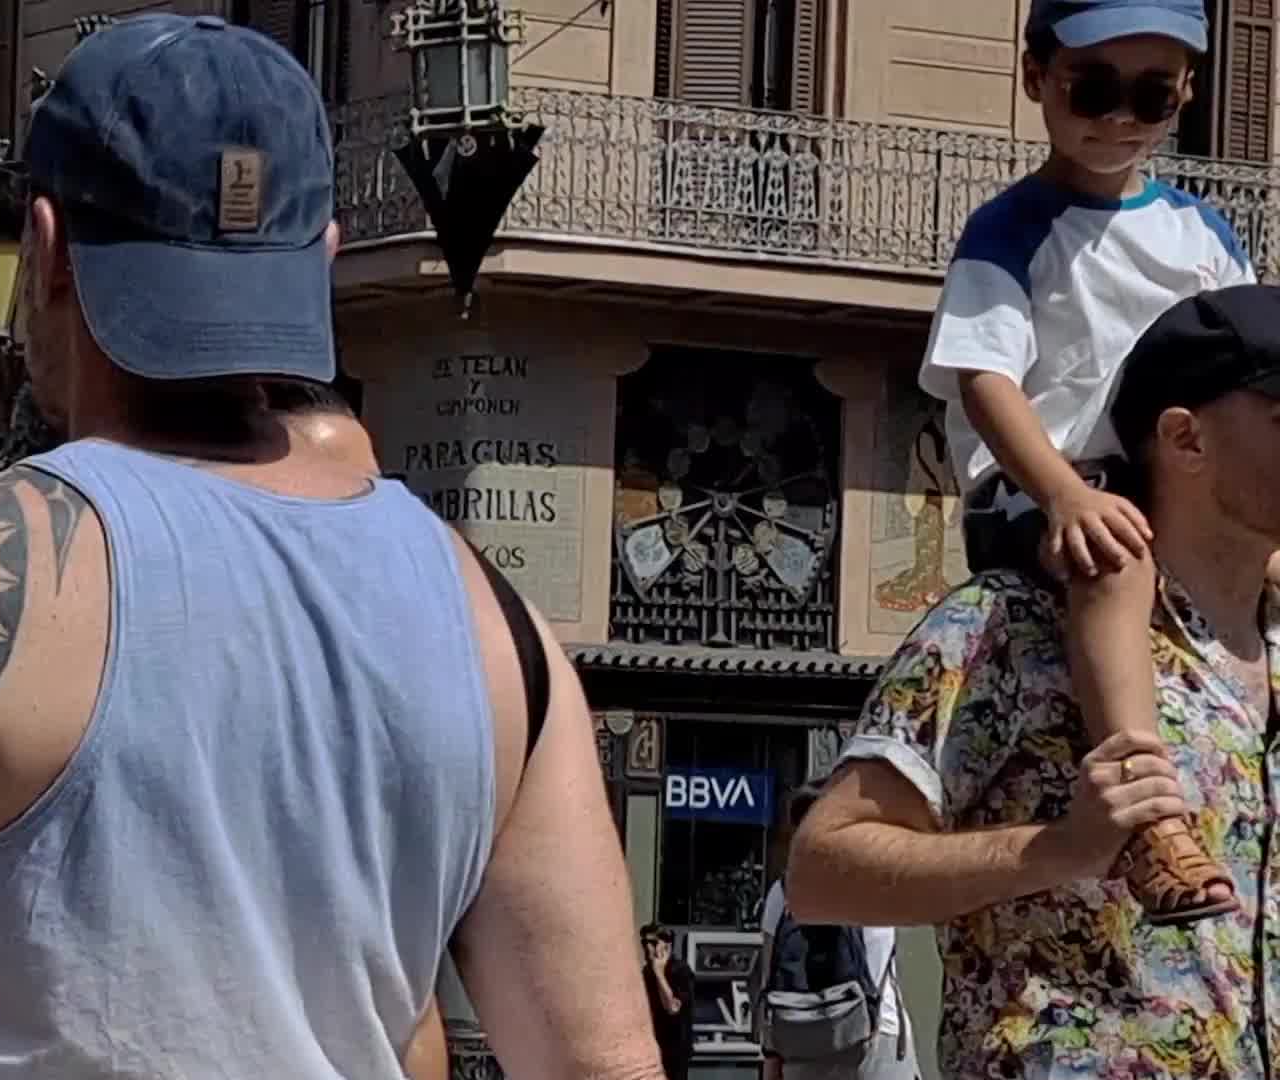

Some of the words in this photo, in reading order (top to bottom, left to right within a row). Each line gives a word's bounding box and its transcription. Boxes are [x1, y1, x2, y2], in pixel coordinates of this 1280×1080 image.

[404, 438, 557, 471] PARAGUAS
[422, 487, 557, 523] MBRILLAS
[480, 544, 526, 569] COS
[665, 775, 755, 808] BBVA
